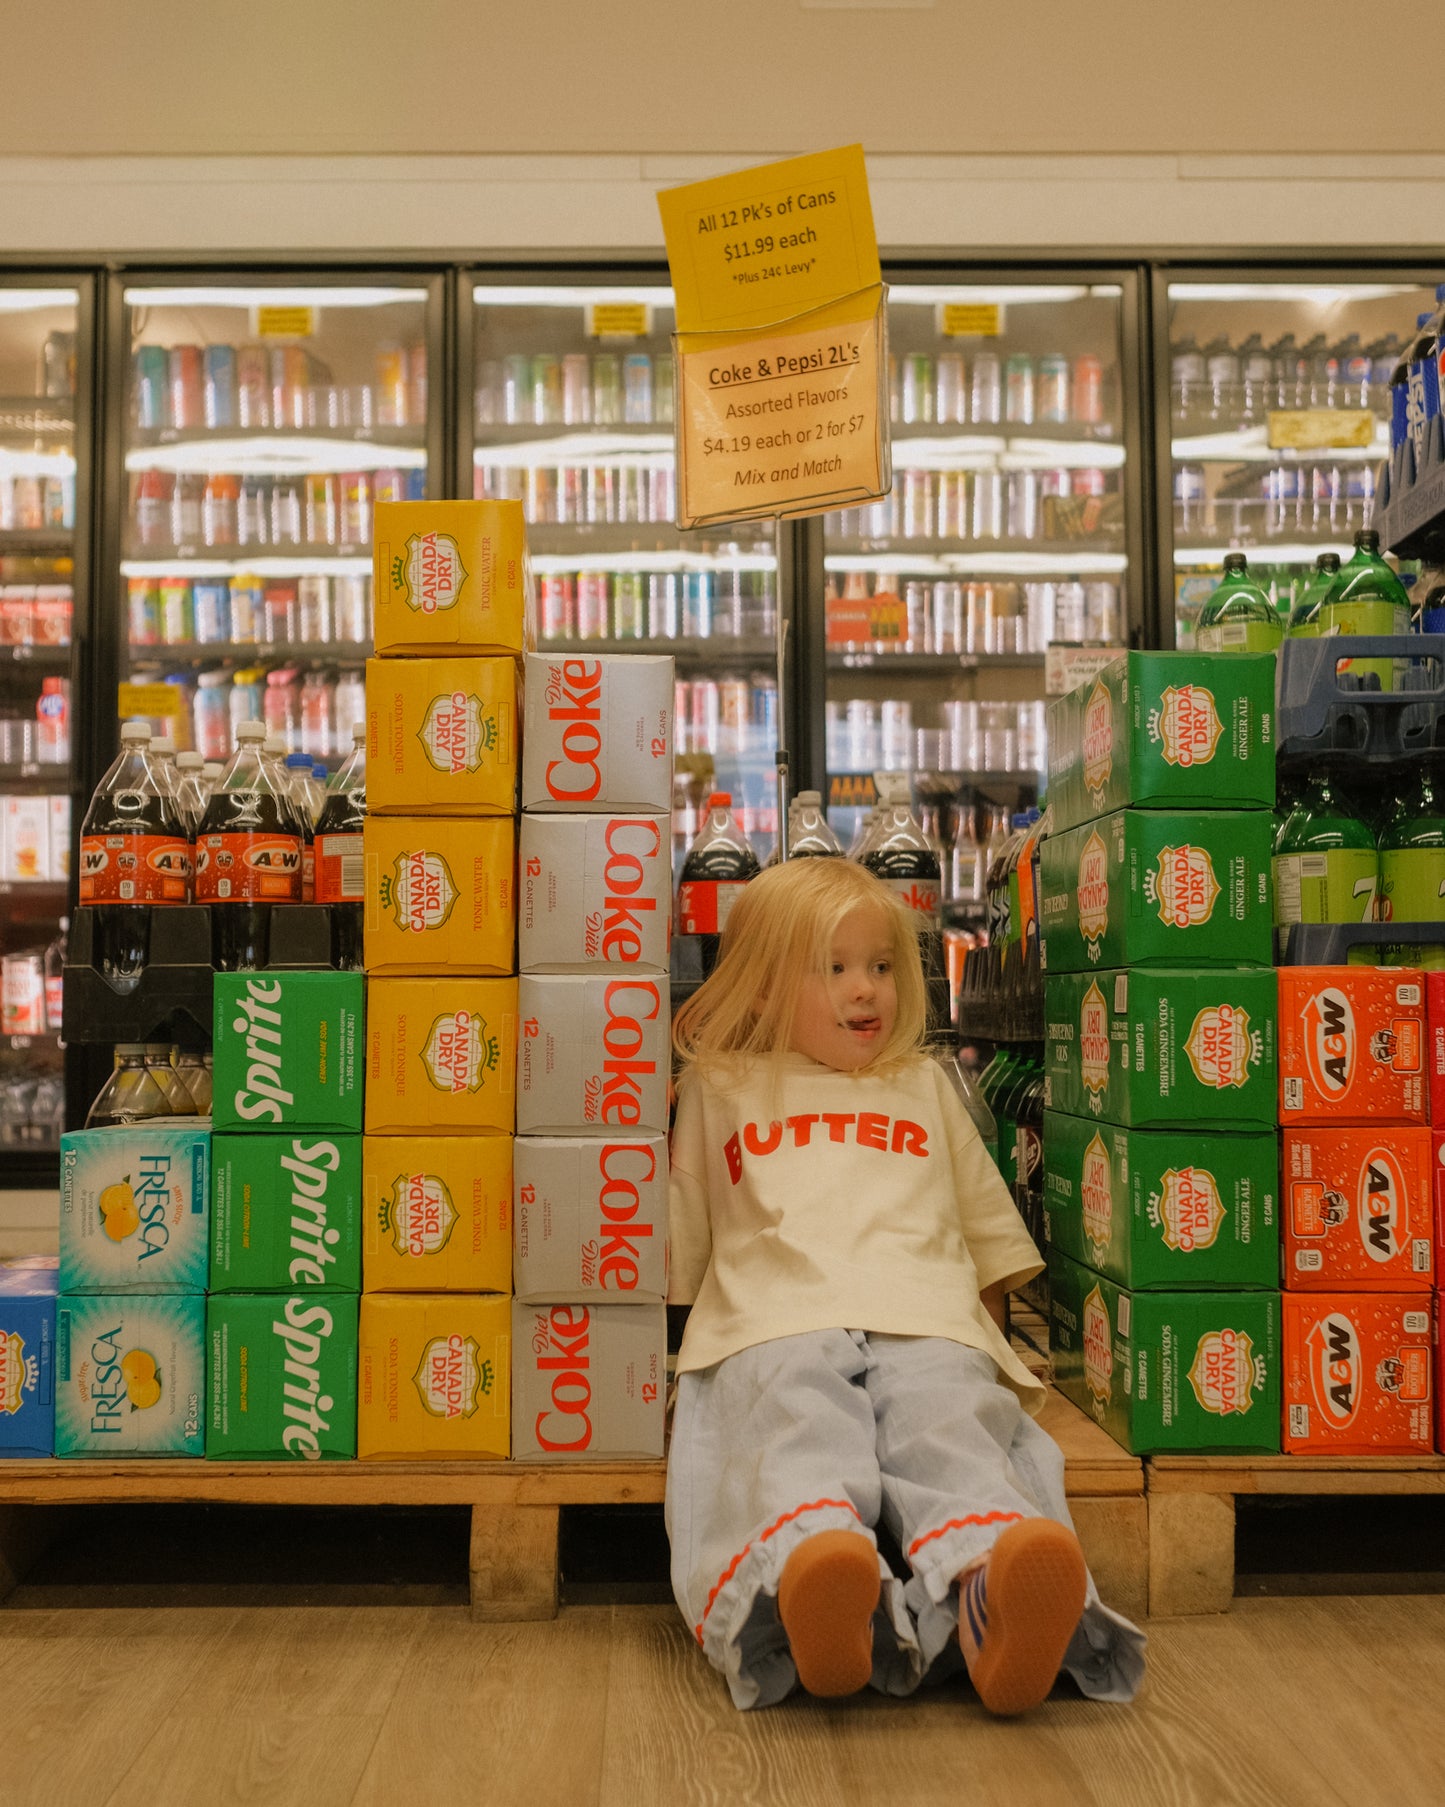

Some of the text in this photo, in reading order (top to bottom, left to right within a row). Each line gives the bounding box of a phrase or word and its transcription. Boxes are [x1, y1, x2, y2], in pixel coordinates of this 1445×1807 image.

[698, 213, 717, 234] All
[722, 211, 738, 227] 12
[777, 196, 793, 215] of
[798, 189, 836, 211] Cans
[724, 227, 817, 263] $11.99 each
[762, 266, 781, 280] 24¢
[709, 342, 860, 385] Coke & Pepsi 2L's
[726, 386, 848, 419] Assorted Flavors
[703, 415, 864, 456] $4.19 each or 2 for $7
[734, 455, 842, 487] Mix and Match
[422, 532, 437, 614] CANADA
[438, 553, 452, 591] DRY
[481, 537, 491, 611] TONIC WATER
[507, 560, 516, 580] CANS
[545, 666, 562, 705] Diet
[394, 694, 403, 774] SODA TONIQUE
[437, 714, 450, 751] DRY
[452, 692, 466, 774] CANADA
[545, 660, 602, 800] Coke
[651, 710, 667, 758] 12 CANS
[1089, 705, 1105, 732] DRY
[1178, 684, 1192, 767] CANADA
[1194, 706, 1208, 744] DRY
[1239, 696, 1248, 761] GINGER ALE
[1262, 713, 1270, 744] 12 CANS
[1083, 726, 1112, 764] CANADA
[254, 851, 298, 867] A&W
[526, 856, 541, 877] 12
[1085, 858, 1101, 882] DRY
[410, 850, 425, 932] CANADA
[426, 872, 440, 910] DRY
[473, 856, 483, 931] TONIC WATER
[500, 879, 508, 909] 12 CANS
[602, 820, 660, 962] Coke
[1078, 883, 1108, 912] CANADA
[1175, 844, 1189, 928] CANADA
[1190, 866, 1205, 905] DRY
[1236, 856, 1245, 920] GINGER ALE
[1258, 873, 1266, 903] 12 CANS
[586, 911, 603, 957] Diète
[1399, 988, 1408, 1000] 170
[524, 1017, 539, 1038] 12
[1087, 1010, 1101, 1034] DRY
[1323, 997, 1347, 1087] A&W
[233, 980, 293, 1123] Sprite
[319, 1042, 327, 1084] LEMON-LIME
[372, 1041, 380, 1079] CANETTES
[395, 1014, 406, 1096] SODA TONIQUE
[440, 1033, 453, 1070] DRY
[453, 1010, 469, 1093] CANADA
[601, 980, 660, 1125] Coke
[1080, 1036, 1109, 1063] CANADA
[1136, 1022, 1144, 1071] 12 CANETTES
[1159, 997, 1169, 1097] SODA GINGEMBRE
[1203, 1026, 1216, 1065] DRY
[1217, 1004, 1232, 1089] CANADA
[1403, 1025, 1411, 1066] ROOT BEER
[1436, 1027, 1445, 1074] 12 CANETTES
[584, 1075, 601, 1122] Diète
[724, 1112, 929, 1185] BUTTER
[64, 1149, 77, 1213] 12 CANETTES
[1089, 1161, 1105, 1188] DRY
[134, 1155, 171, 1261] FRESCA
[280, 1140, 340, 1285] Sprite
[409, 1173, 424, 1257] CANADA
[426, 1196, 440, 1234] DRY
[473, 1177, 482, 1254] TONIC WATER
[500, 1200, 508, 1230] 12 CANS
[520, 1183, 535, 1257] 12 CANETTES
[599, 1144, 656, 1290] Coke
[1081, 1184, 1112, 1220] CANADA
[1179, 1166, 1194, 1252] CANADA
[1195, 1188, 1209, 1229] DRY
[1241, 1177, 1250, 1243] GINGER ALE
[1264, 1194, 1272, 1226] 12 CANS
[1303, 1188, 1313, 1231] RACINETTE
[1367, 1163, 1390, 1255] A&W
[242, 1204, 250, 1248] CITRON-LIME
[581, 1239, 598, 1287] Diète
[1308, 1254, 1318, 1265] 170
[532, 1314, 549, 1354] Diet
[1090, 1312, 1104, 1343] DRY
[1406, 1316, 1416, 1328] 170
[364, 1356, 371, 1364] 12
[433, 1356, 446, 1395] DRY
[447, 1334, 462, 1418] CANADA
[1084, 1335, 1112, 1376] CANADA
[1138, 1349, 1147, 1400] 12 CANETTES
[1162, 1325, 1172, 1426] SODA GINGEMBRE
[1206, 1352, 1219, 1391] DRY
[1221, 1328, 1235, 1416] CANADA
[1328, 1322, 1352, 1414] A&W
[1410, 1353, 1418, 1395] ROOT BEER
[76, 1361, 90, 1401] sugar-free
[90, 1325, 127, 1434] FRESCA
[273, 1298, 333, 1460] Sprite
[388, 1338, 398, 1423] SODA TONIQUE
[536, 1304, 592, 1452] Coke
[642, 1383, 657, 1404] 12
[184, 1393, 199, 1439] 12 CANS
